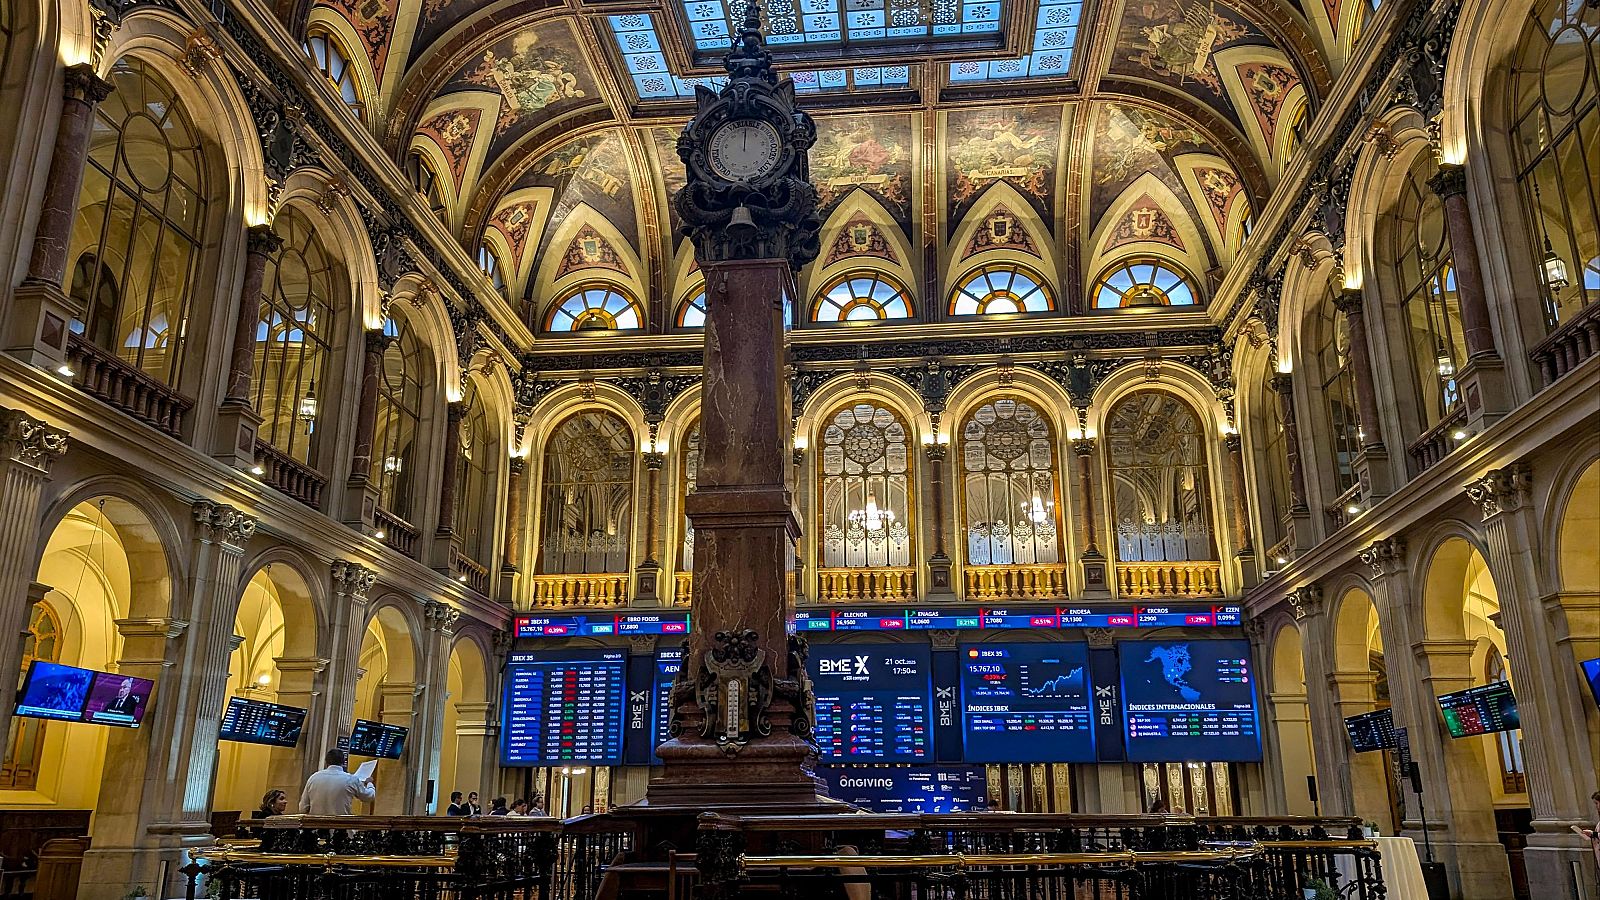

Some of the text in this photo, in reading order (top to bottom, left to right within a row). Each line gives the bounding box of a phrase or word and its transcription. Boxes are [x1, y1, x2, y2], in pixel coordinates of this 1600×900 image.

[727, 121, 762, 131] VARIABLE
[758, 144, 778, 174] MUY SECO
[820, 659, 851, 671] BME
[632, 704, 642, 729] BME
[940, 701, 950, 725] BME
[1100, 700, 1110, 725] BME
